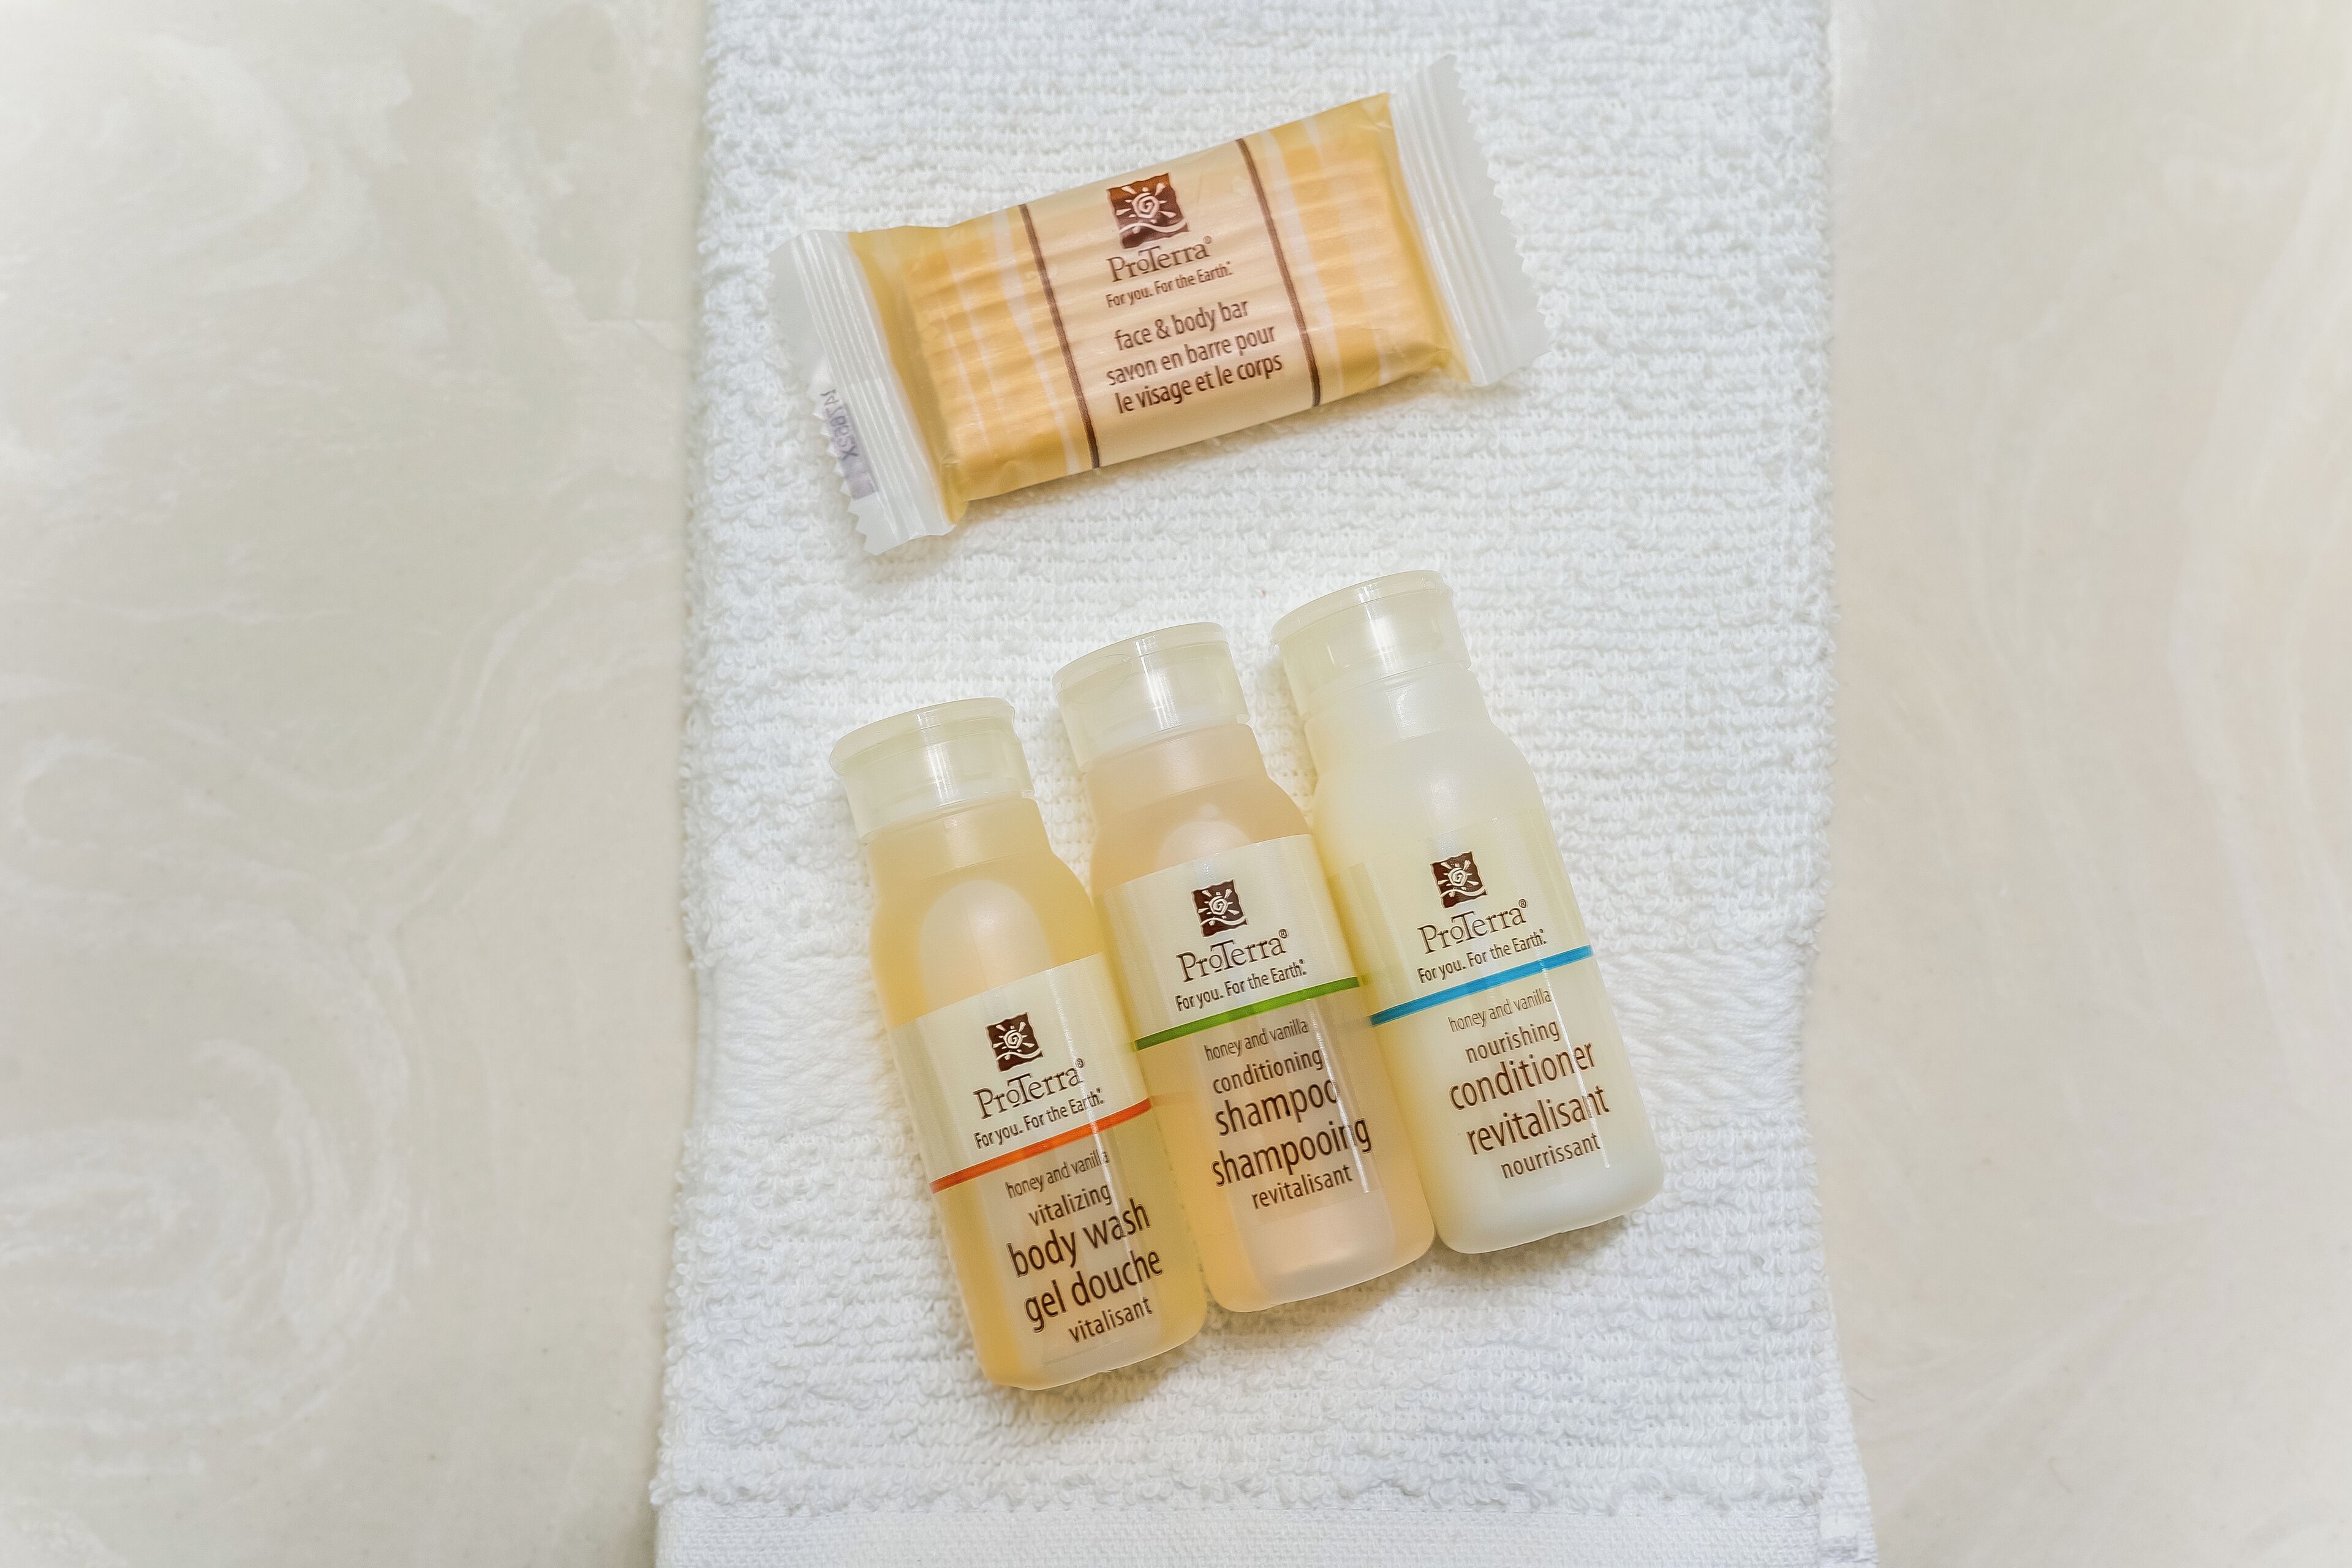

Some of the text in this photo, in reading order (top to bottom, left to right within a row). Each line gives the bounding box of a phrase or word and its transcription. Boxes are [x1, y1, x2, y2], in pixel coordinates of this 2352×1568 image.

[1106, 293, 1125, 307] For
[1128, 287, 1153, 305] you.
[1155, 280, 1174, 294] For
[1176, 274, 1195, 288] the
[1114, 301, 1248, 350] face & body bar
[1106, 326, 1275, 385] savon en barre pour
[1115, 355, 1283, 414] le visage et le corps
[1417, 968, 1437, 983] For
[1439, 959, 1466, 979] you.
[1467, 952, 1487, 967] For
[1490, 944, 1510, 960] the
[1175, 995, 1195, 1011] For
[1196, 988, 1223, 1009] you.
[1224, 981, 1245, 996] For
[1248, 974, 1269, 989] the
[1449, 987, 1551, 1032] honey and vanilla
[1204, 1019, 1309, 1061] honey and vanilla
[1465, 1021, 1559, 1063] nourishing
[1213, 1049, 1324, 1093] conditioning
[1449, 1042, 1595, 1110] conditioner
[974, 1133, 993, 1148] For
[995, 1123, 1023, 1145] you.
[1023, 1113, 1044, 1129] For
[1046, 1106, 1068, 1122] the
[1466, 1085, 1610, 1155] revitalisant
[1005, 1150, 1109, 1198] honey and vanilla
[1212, 1118, 1371, 1186] shampooing
[1501, 1133, 1600, 1178] nourrissant
[1028, 1184, 1112, 1226] vitalizing
[1251, 1165, 1352, 1209] revitalisant
[1006, 1197, 1150, 1278] body wash
[1024, 1250, 1162, 1332] gel douche
[1068, 1297, 1152, 1342] vitalisant
